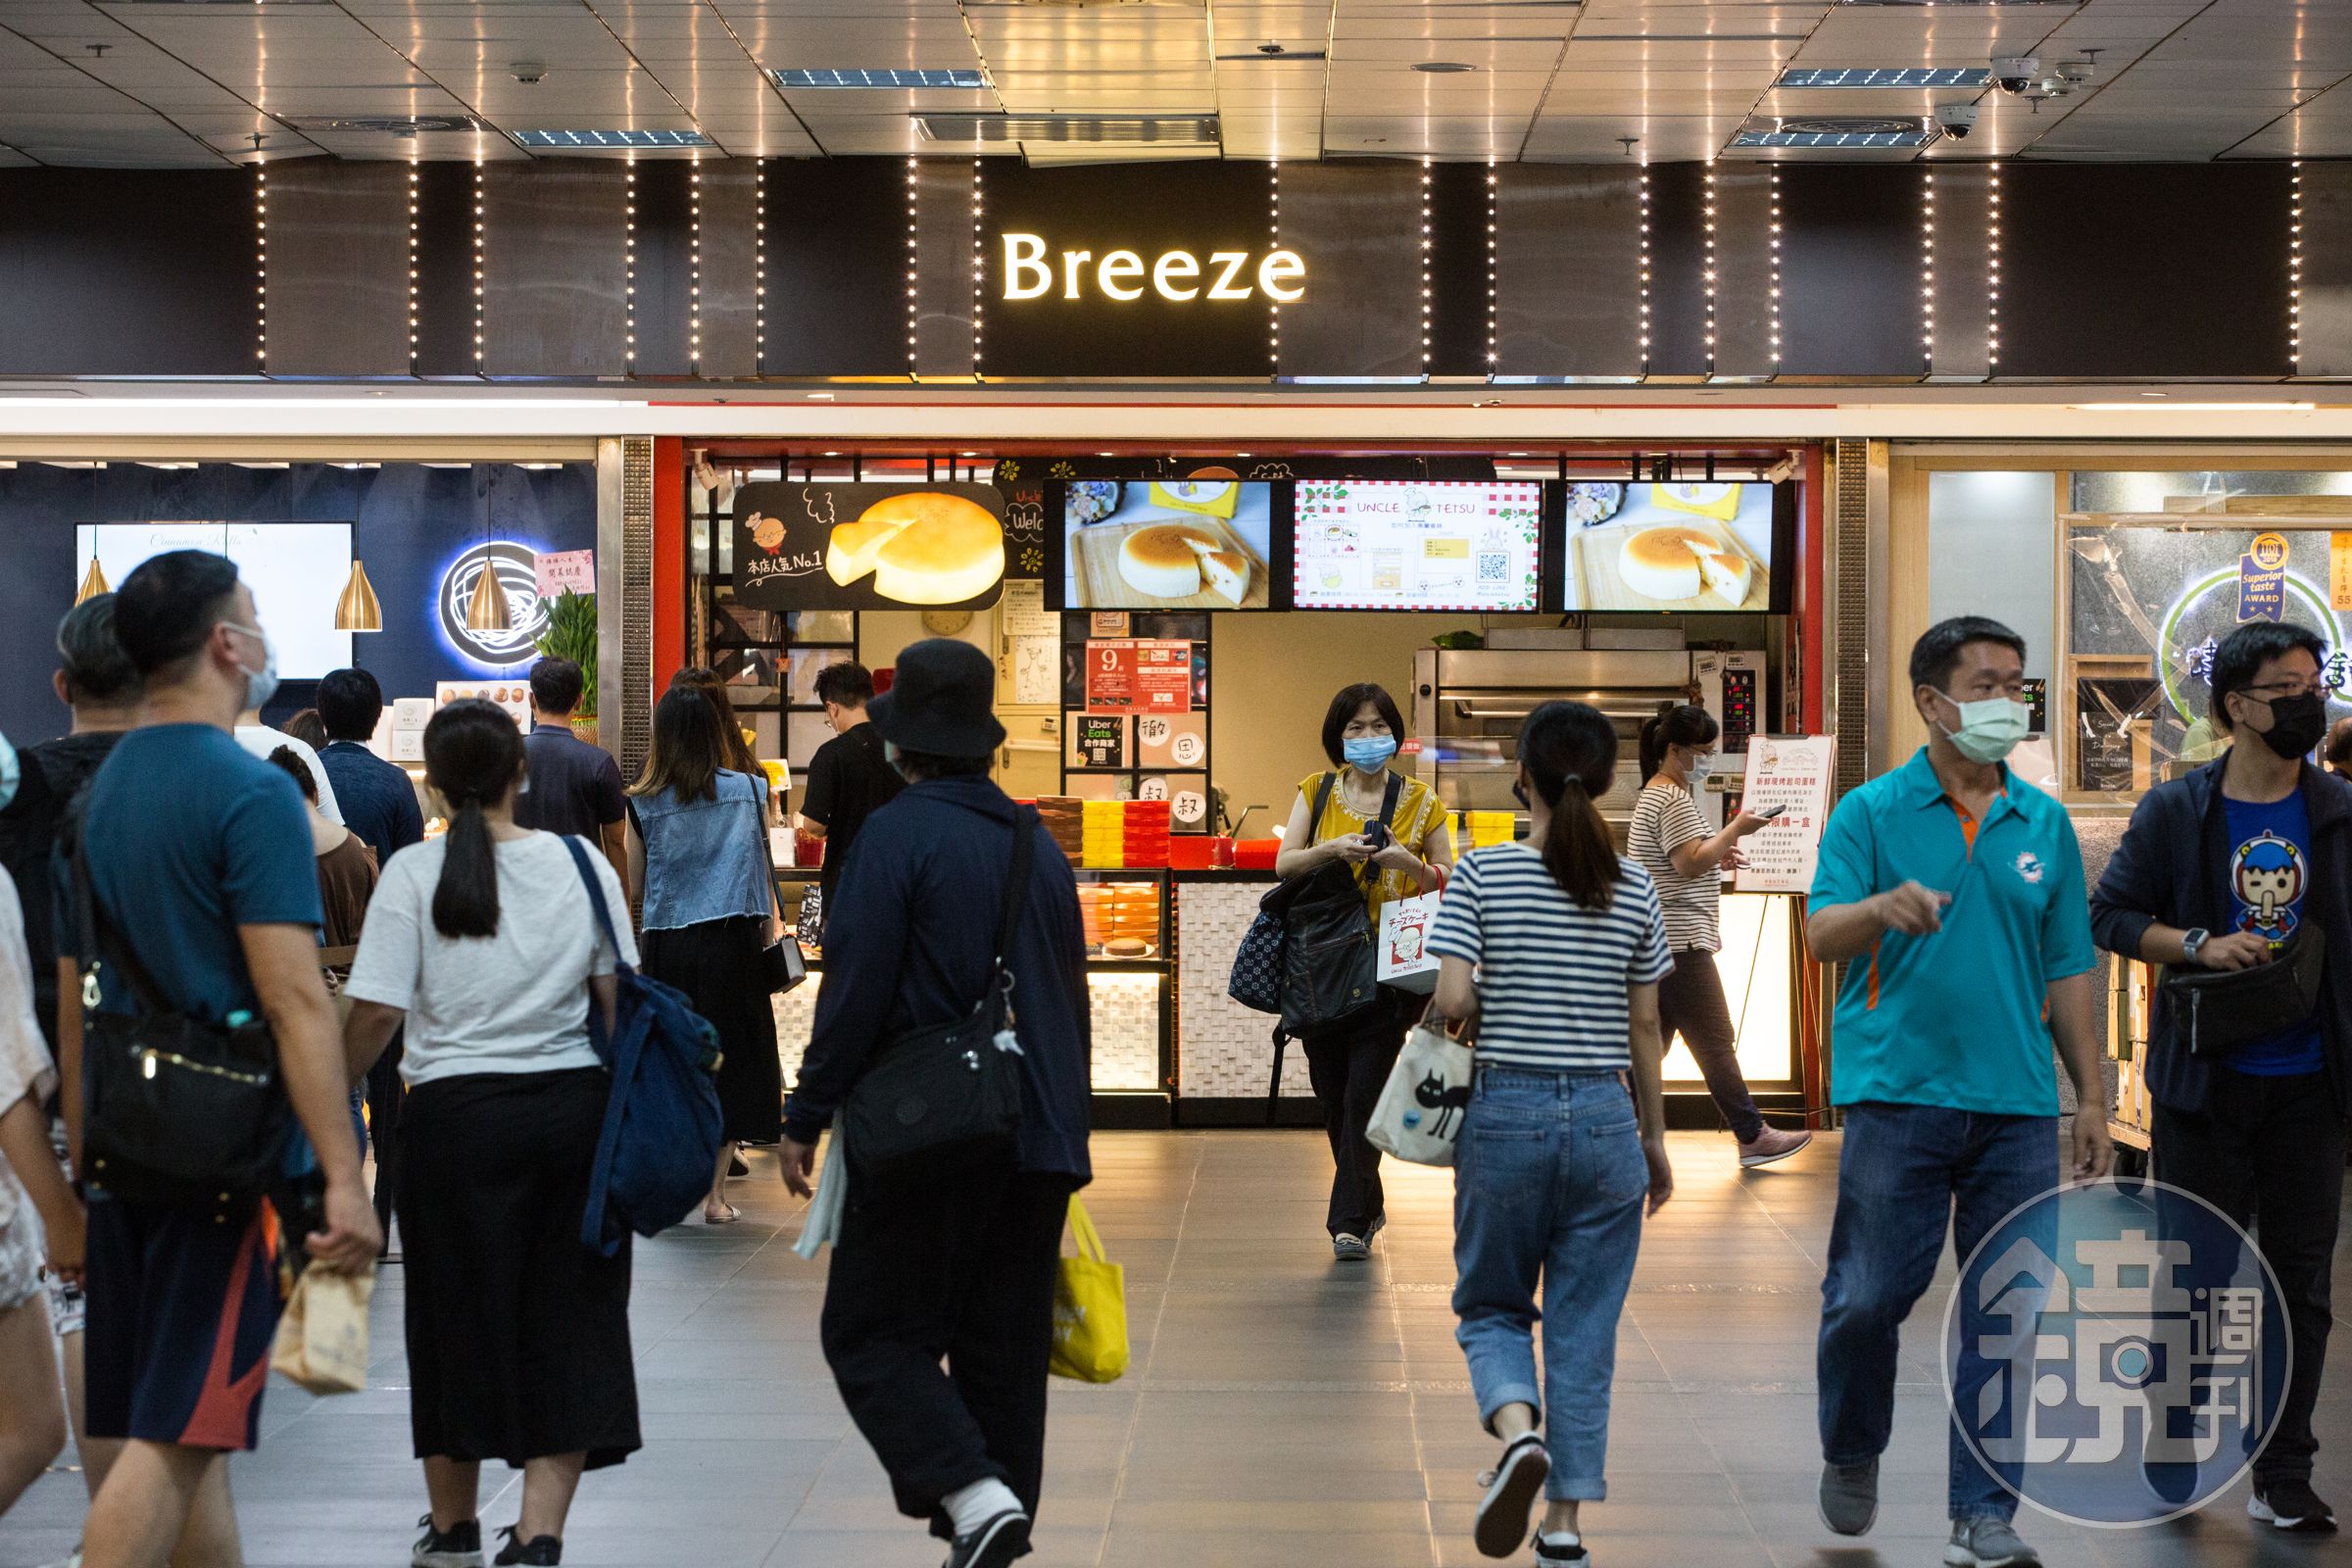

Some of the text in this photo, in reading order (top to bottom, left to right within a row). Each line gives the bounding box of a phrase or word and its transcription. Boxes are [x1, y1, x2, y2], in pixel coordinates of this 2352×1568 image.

[1001, 233, 1306, 301] Breeze
[1357, 503, 1476, 514] UNCLE TETSU
[793, 550, 822, 568] No.1
[2242, 571, 2283, 584] Superior
[2250, 581, 2276, 592] taste
[2244, 594, 2279, 603] AWARD
[1088, 719, 1111, 729] Uber
[1088, 729, 1111, 738] Eats
[1084, 739, 1115, 748] 合作商家
[1768, 816, 1810, 828] 限購一盒
[1388, 912, 1429, 927] チーズケーキ
